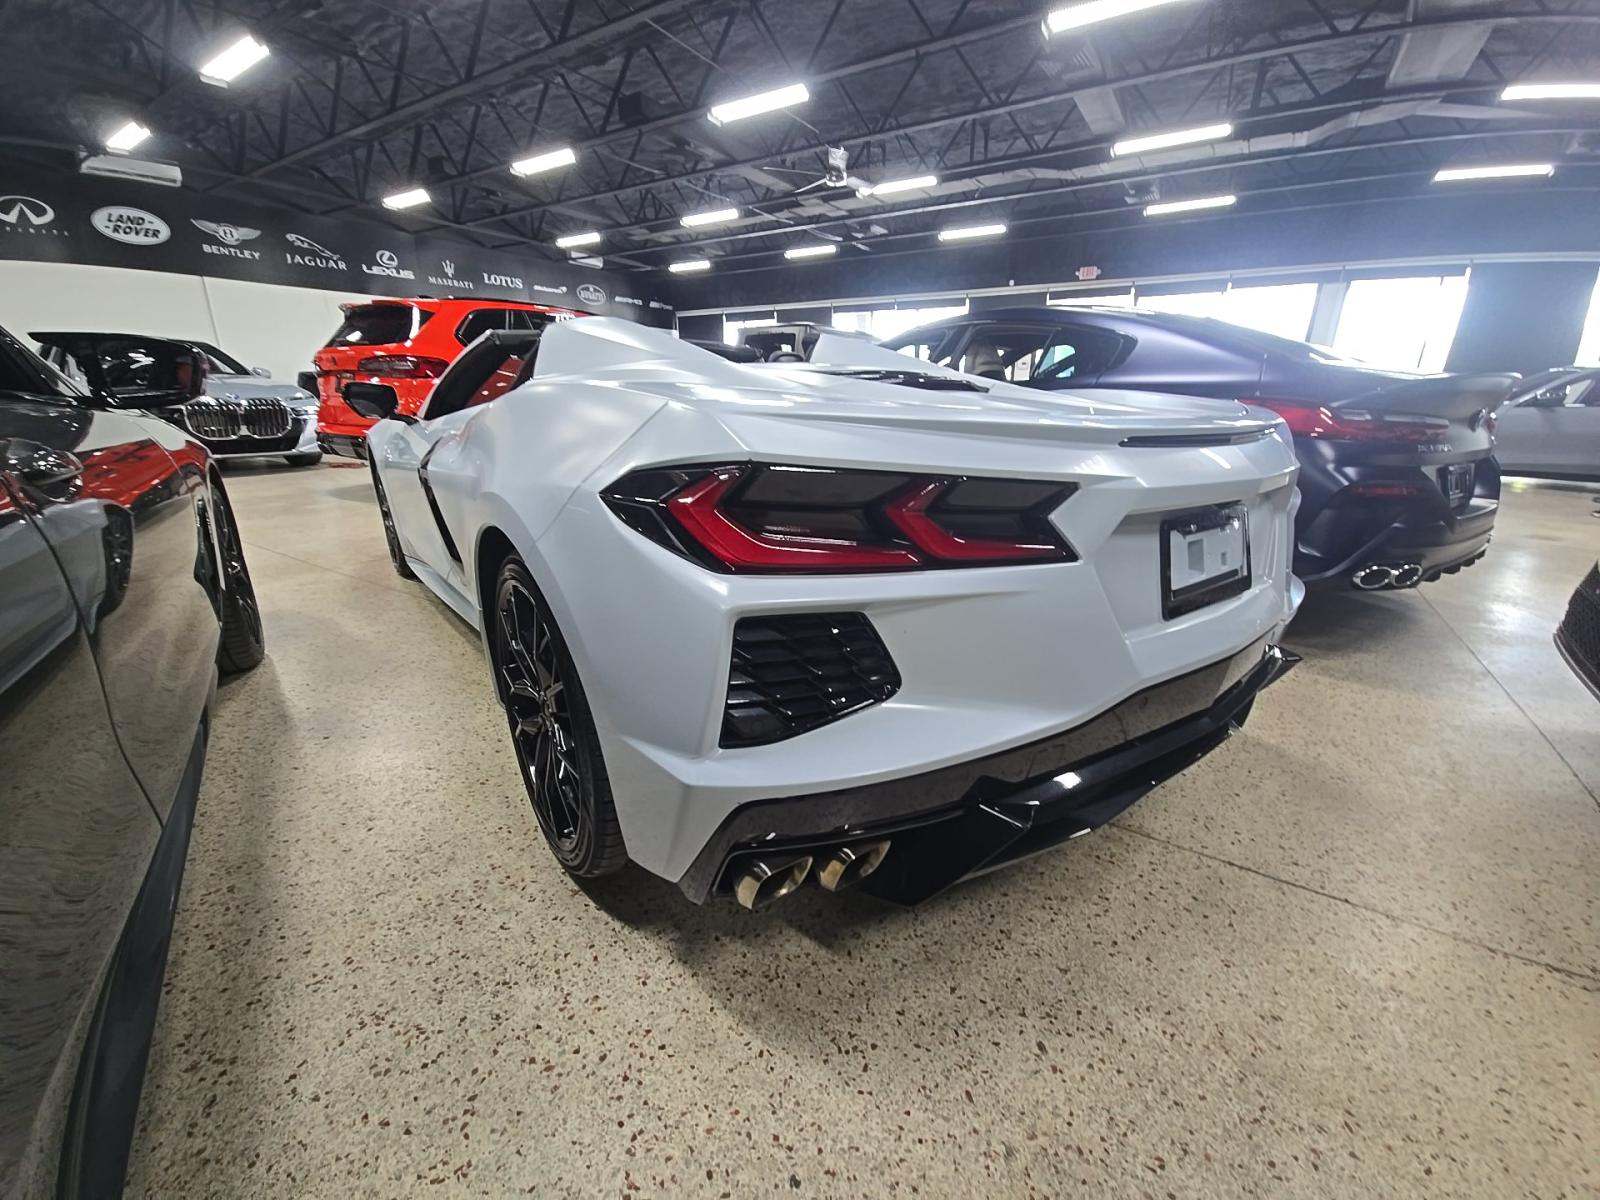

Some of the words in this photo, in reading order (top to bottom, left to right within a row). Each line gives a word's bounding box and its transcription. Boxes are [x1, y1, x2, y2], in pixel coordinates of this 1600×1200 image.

[202, 243, 261, 260] BENTLEY
[286, 253, 348, 271] JAGUAR
[361, 263, 416, 280] LEXUS
[428, 276, 474, 290] MASERATI
[483, 272, 523, 289] LOTUS
